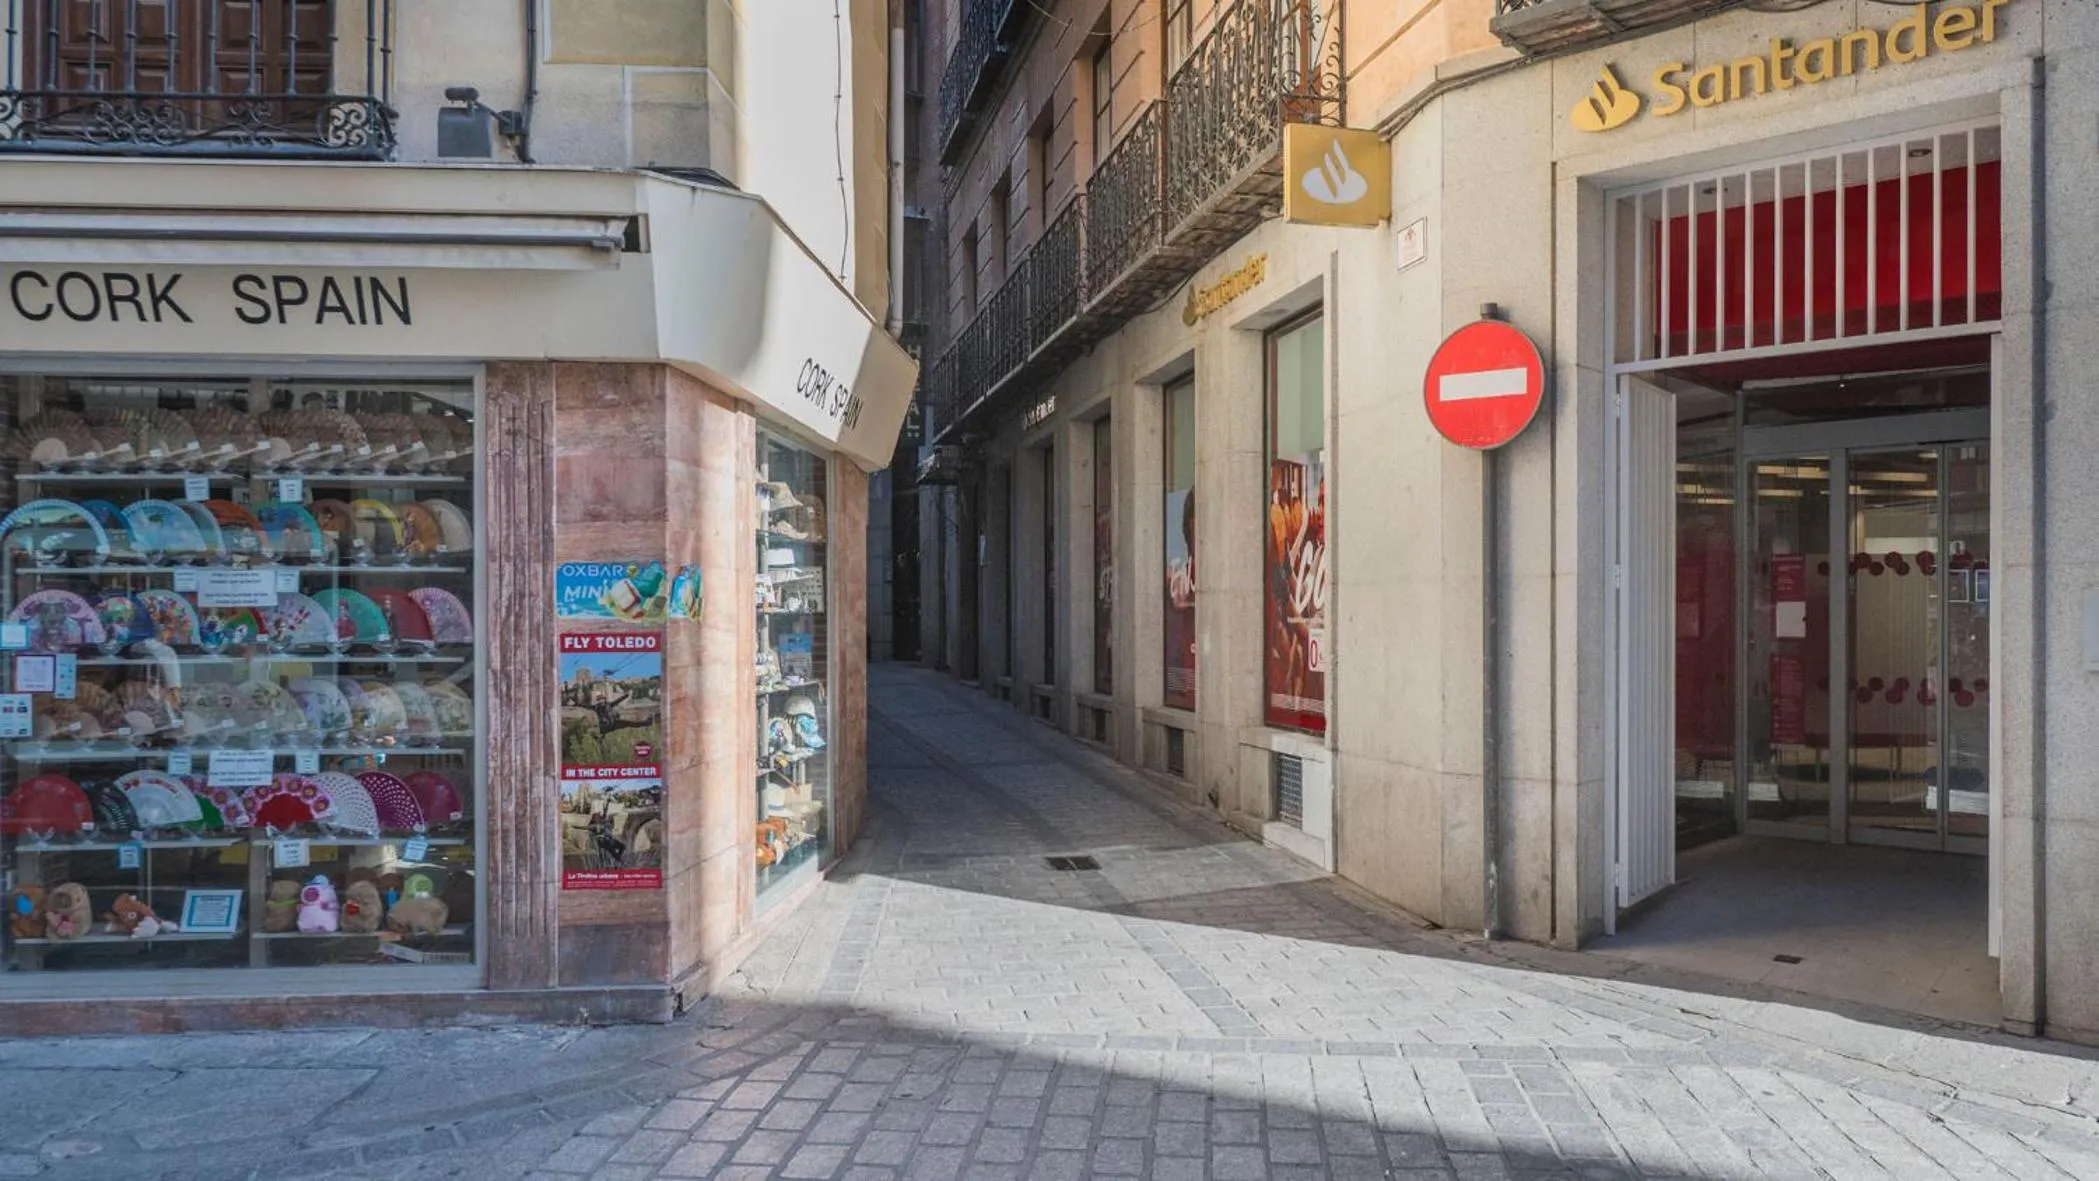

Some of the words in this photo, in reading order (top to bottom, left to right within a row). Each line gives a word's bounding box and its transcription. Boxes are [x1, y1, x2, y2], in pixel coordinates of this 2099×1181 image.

[1652, 0, 2006, 117] Santander
[9, 269, 194, 323] CORK
[232, 273, 413, 326] SPAIN
[797, 357, 835, 410] CORK
[829, 384, 864, 431] SPAIN
[561, 563, 624, 578] OXBAR
[563, 636, 591, 650] FLY
[595, 635, 657, 650] TOLEDO
[566, 767, 576, 778] IN
[577, 767, 596, 778] THE
[598, 767, 619, 777] CITY
[620, 766, 657, 777] CENTER
